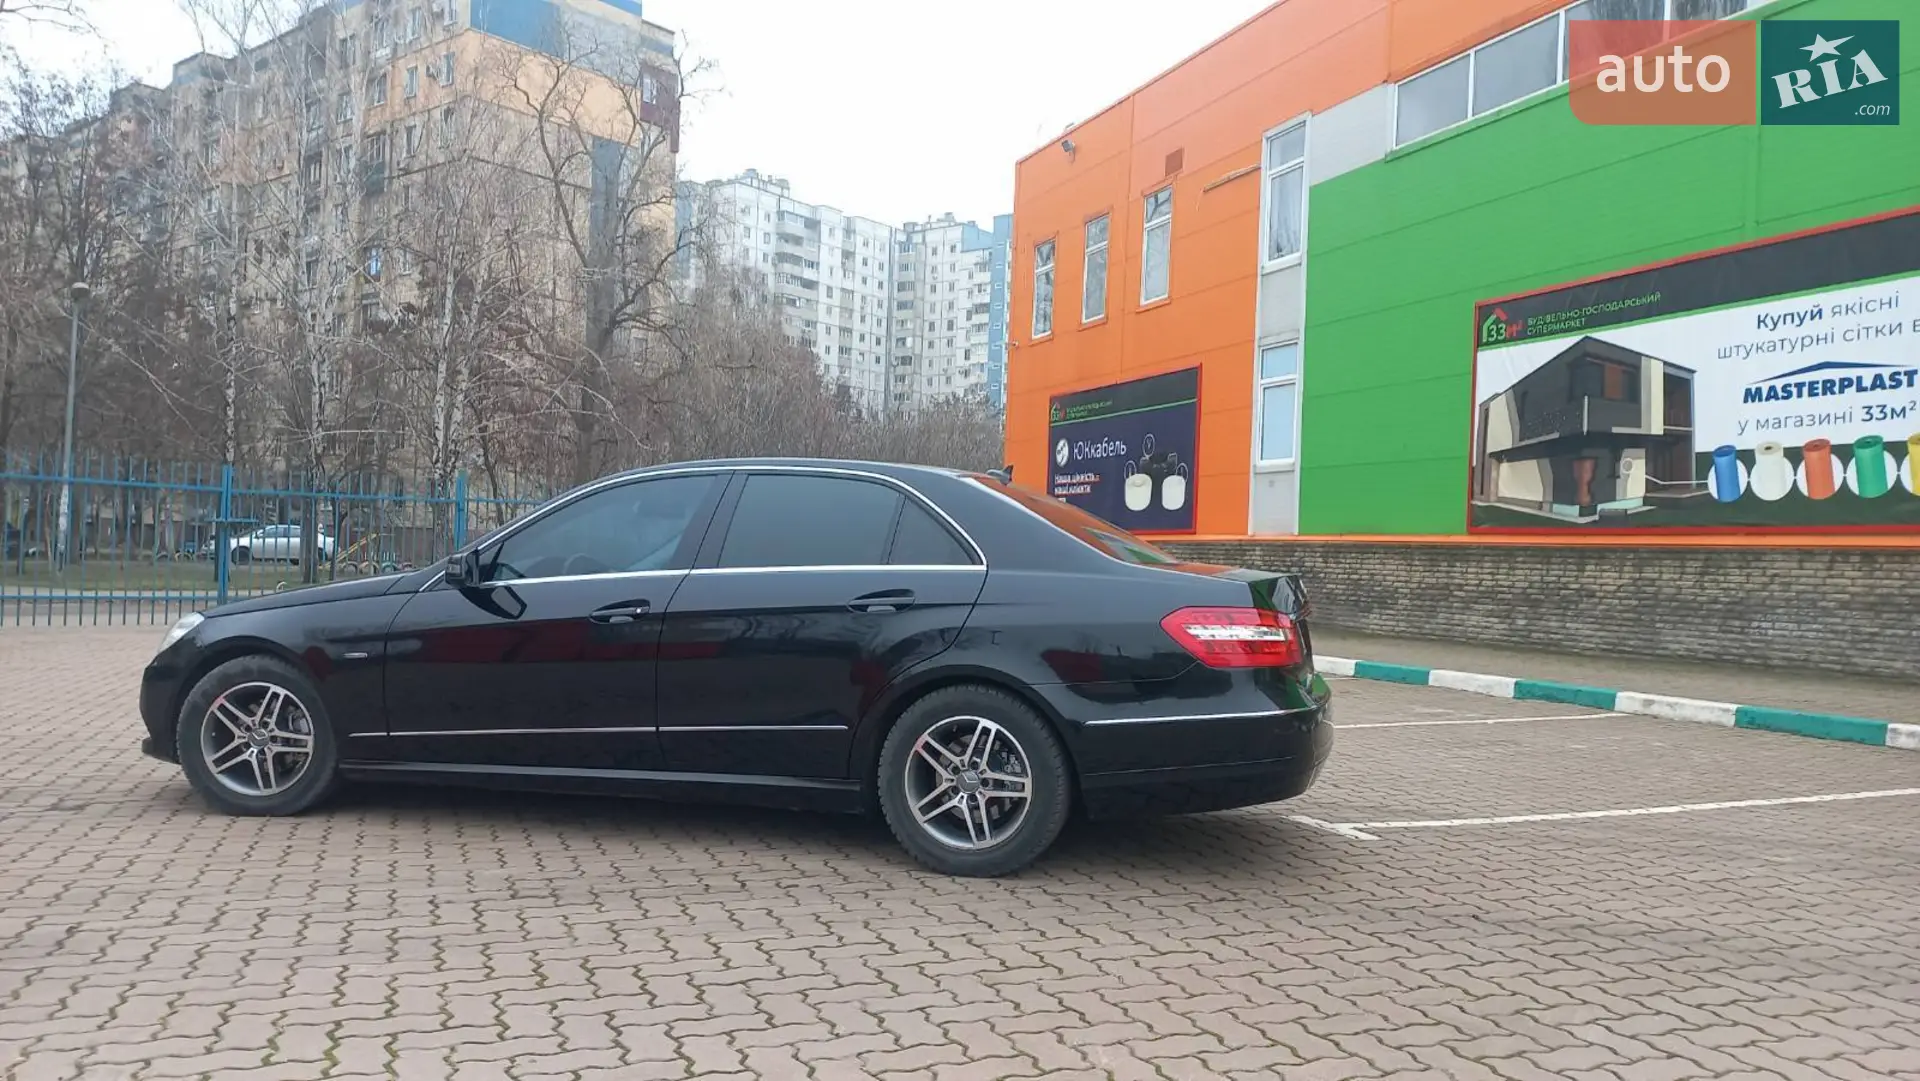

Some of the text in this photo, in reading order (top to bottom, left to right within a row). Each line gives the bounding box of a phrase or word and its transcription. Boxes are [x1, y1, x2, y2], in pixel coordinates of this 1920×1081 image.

[1527, 318, 1586, 336] СУПЕРМАРКЕТ
[1757, 291, 1900, 332] Купуй якісні
[1717, 328, 1835, 360] штукатурні
[1842, 321, 1902, 343] сітки
[1742, 368, 1918, 404] MASTERPLAST
[1737, 419, 1749, 436] у
[1756, 406, 1853, 431] магазині
[1073, 436, 1127, 461] ЮКкабель
